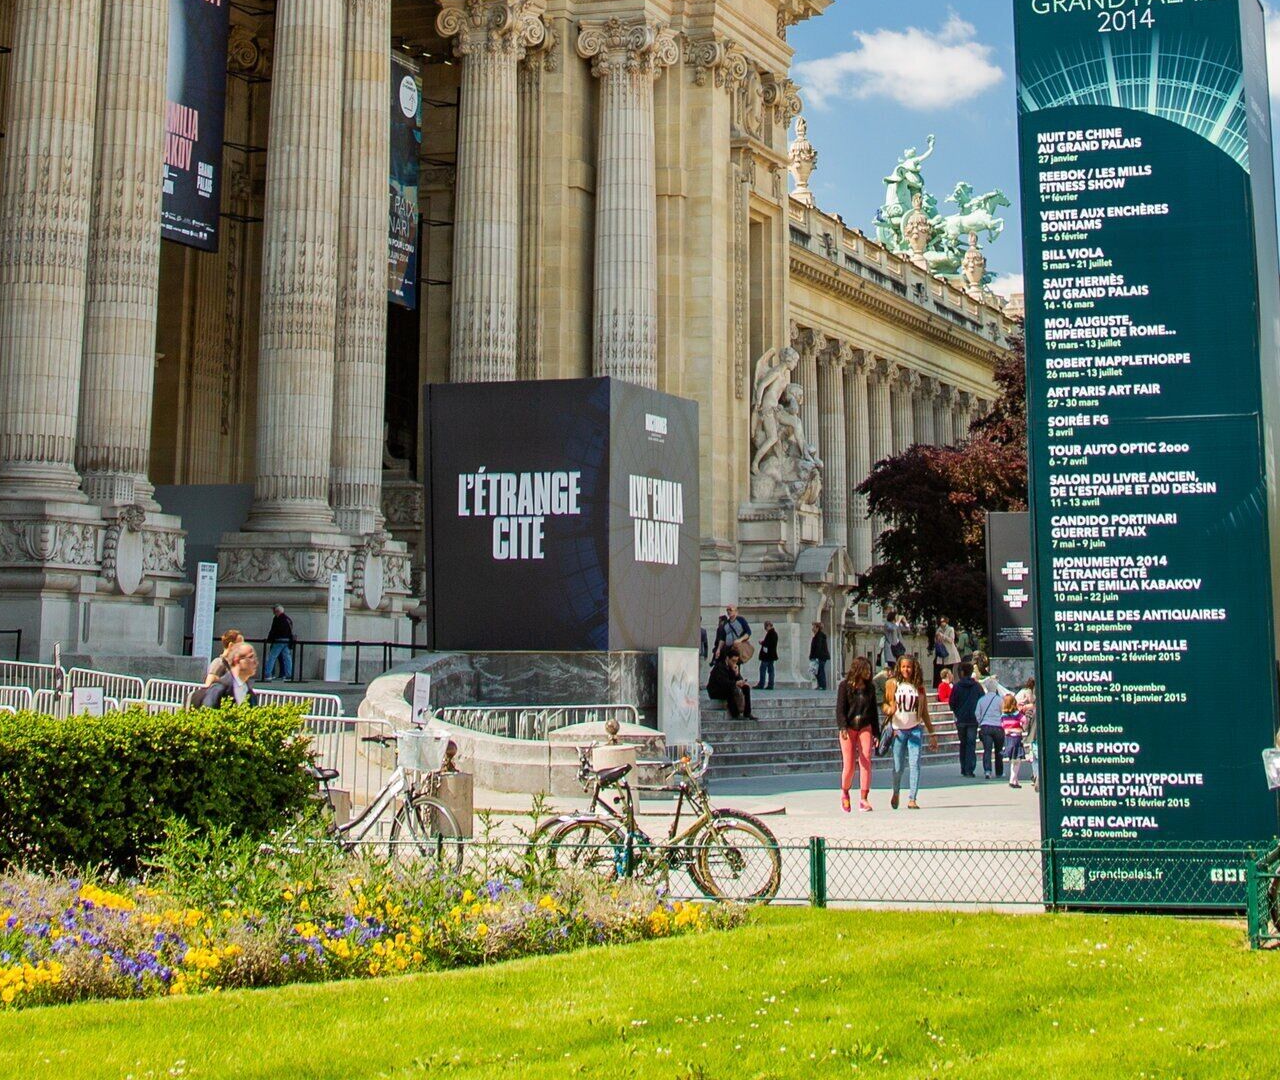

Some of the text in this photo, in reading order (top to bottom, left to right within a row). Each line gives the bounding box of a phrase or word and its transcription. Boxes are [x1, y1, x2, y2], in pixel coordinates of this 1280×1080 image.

[1098, 8, 1156, 33] 2014
[1038, 128, 1122, 143] NUIT DE CHINE
[1038, 137, 1142, 154] AU GRAND PALAIS
[1039, 154, 1078, 164] 27 janvier
[1039, 169, 1086, 182] REEBOK
[1095, 167, 1116, 178] LES
[1118, 165, 1152, 177] MILLS
[1040, 178, 1125, 193] FITNESS SHOW
[1052, 193, 1078, 201] février
[1040, 203, 1169, 221] VENTE AUX ENCHÈRES
[1041, 219, 1102, 232] BONHAMS
[1042, 247, 1104, 260] BILL VIOLA
[1043, 274, 1124, 289] SAUT HERMÈS
[1043, 285, 1149, 300] AU GRAND PALAIS
[1045, 315, 1132, 329] MOI, AUGUSTE,
[1045, 327, 1108, 340] EMPEREUR
[1110, 326, 1127, 337] DE
[1046, 353, 1190, 369] ROBERT MAPPLETHORPE
[1047, 384, 1160, 398] ART PARIS ART FAIR
[1048, 414, 1109, 427] SOIRÉE FG
[1048, 427, 1073, 437] 3 avril
[1048, 445, 1081, 456] TOUR
[1083, 444, 1117, 455] AUTO
[1119, 443, 1157, 454] OPTIC
[1050, 471, 1199, 485] SALON DU LIVRE ANCIEN,
[458, 465, 581, 517] L'ÉTRANGE
[1050, 486, 1067, 496] DE
[1135, 484, 1150, 494] ET
[1151, 483, 1170, 494] DU
[1172, 482, 1216, 494] DESSIN
[629, 474, 648, 519] ILYA
[653, 478, 683, 524] EMILIA
[1051, 513, 1177, 526] CANDIDO PORTINARI
[492, 511, 545, 560] CITÉ
[1051, 526, 1146, 537] GUERRE ET PAIX
[634, 519, 679, 565] KABAKOV
[1053, 555, 1167, 568] MONUMENTA 2014
[1120, 567, 1147, 578] CITÉ
[1054, 579, 1201, 591] ILYA ET EMILIA KABAKOV
[1055, 609, 1226, 621] BIENNALE DES ANTIQUAIRES
[1056, 640, 1187, 651] NIKI DE SAINT-PHALLE
[1056, 653, 1067, 662] 17
[1069, 653, 1114, 662] septembre
[1122, 653, 1127, 661] 2
[1129, 652, 1156, 661] février
[1159, 652, 1181, 661] 2015
[1057, 671, 1112, 682] HOKUSAI
[1069, 683, 1102, 692] octobre
[1110, 683, 1121, 692] 20
[1123, 683, 1165, 692] novembre
[1070, 693, 1112, 702] décembre
[1121, 693, 1132, 702] 18
[1133, 693, 1163, 703] janvier
[1165, 693, 1186, 702] 2015
[1058, 712, 1086, 722] FIAC
[1059, 724, 1069, 733] 23
[1077, 724, 1089, 733] 26
[1090, 724, 1123, 733] octobre
[1059, 742, 1140, 753] PARIS PHOTO
[1060, 773, 1074, 784] LE
[1077, 773, 1120, 784] BAISER
[1060, 786, 1079, 796] OU
[1061, 798, 1072, 806] 19
[1074, 798, 1117, 806] novembre
[1125, 798, 1136, 807] 15
[1138, 798, 1165, 807] février
[1168, 799, 1190, 807] 2015
[1061, 817, 1158, 827] ART EN CAPITAL
[1088, 868, 1164, 881] grandpalais.fr
